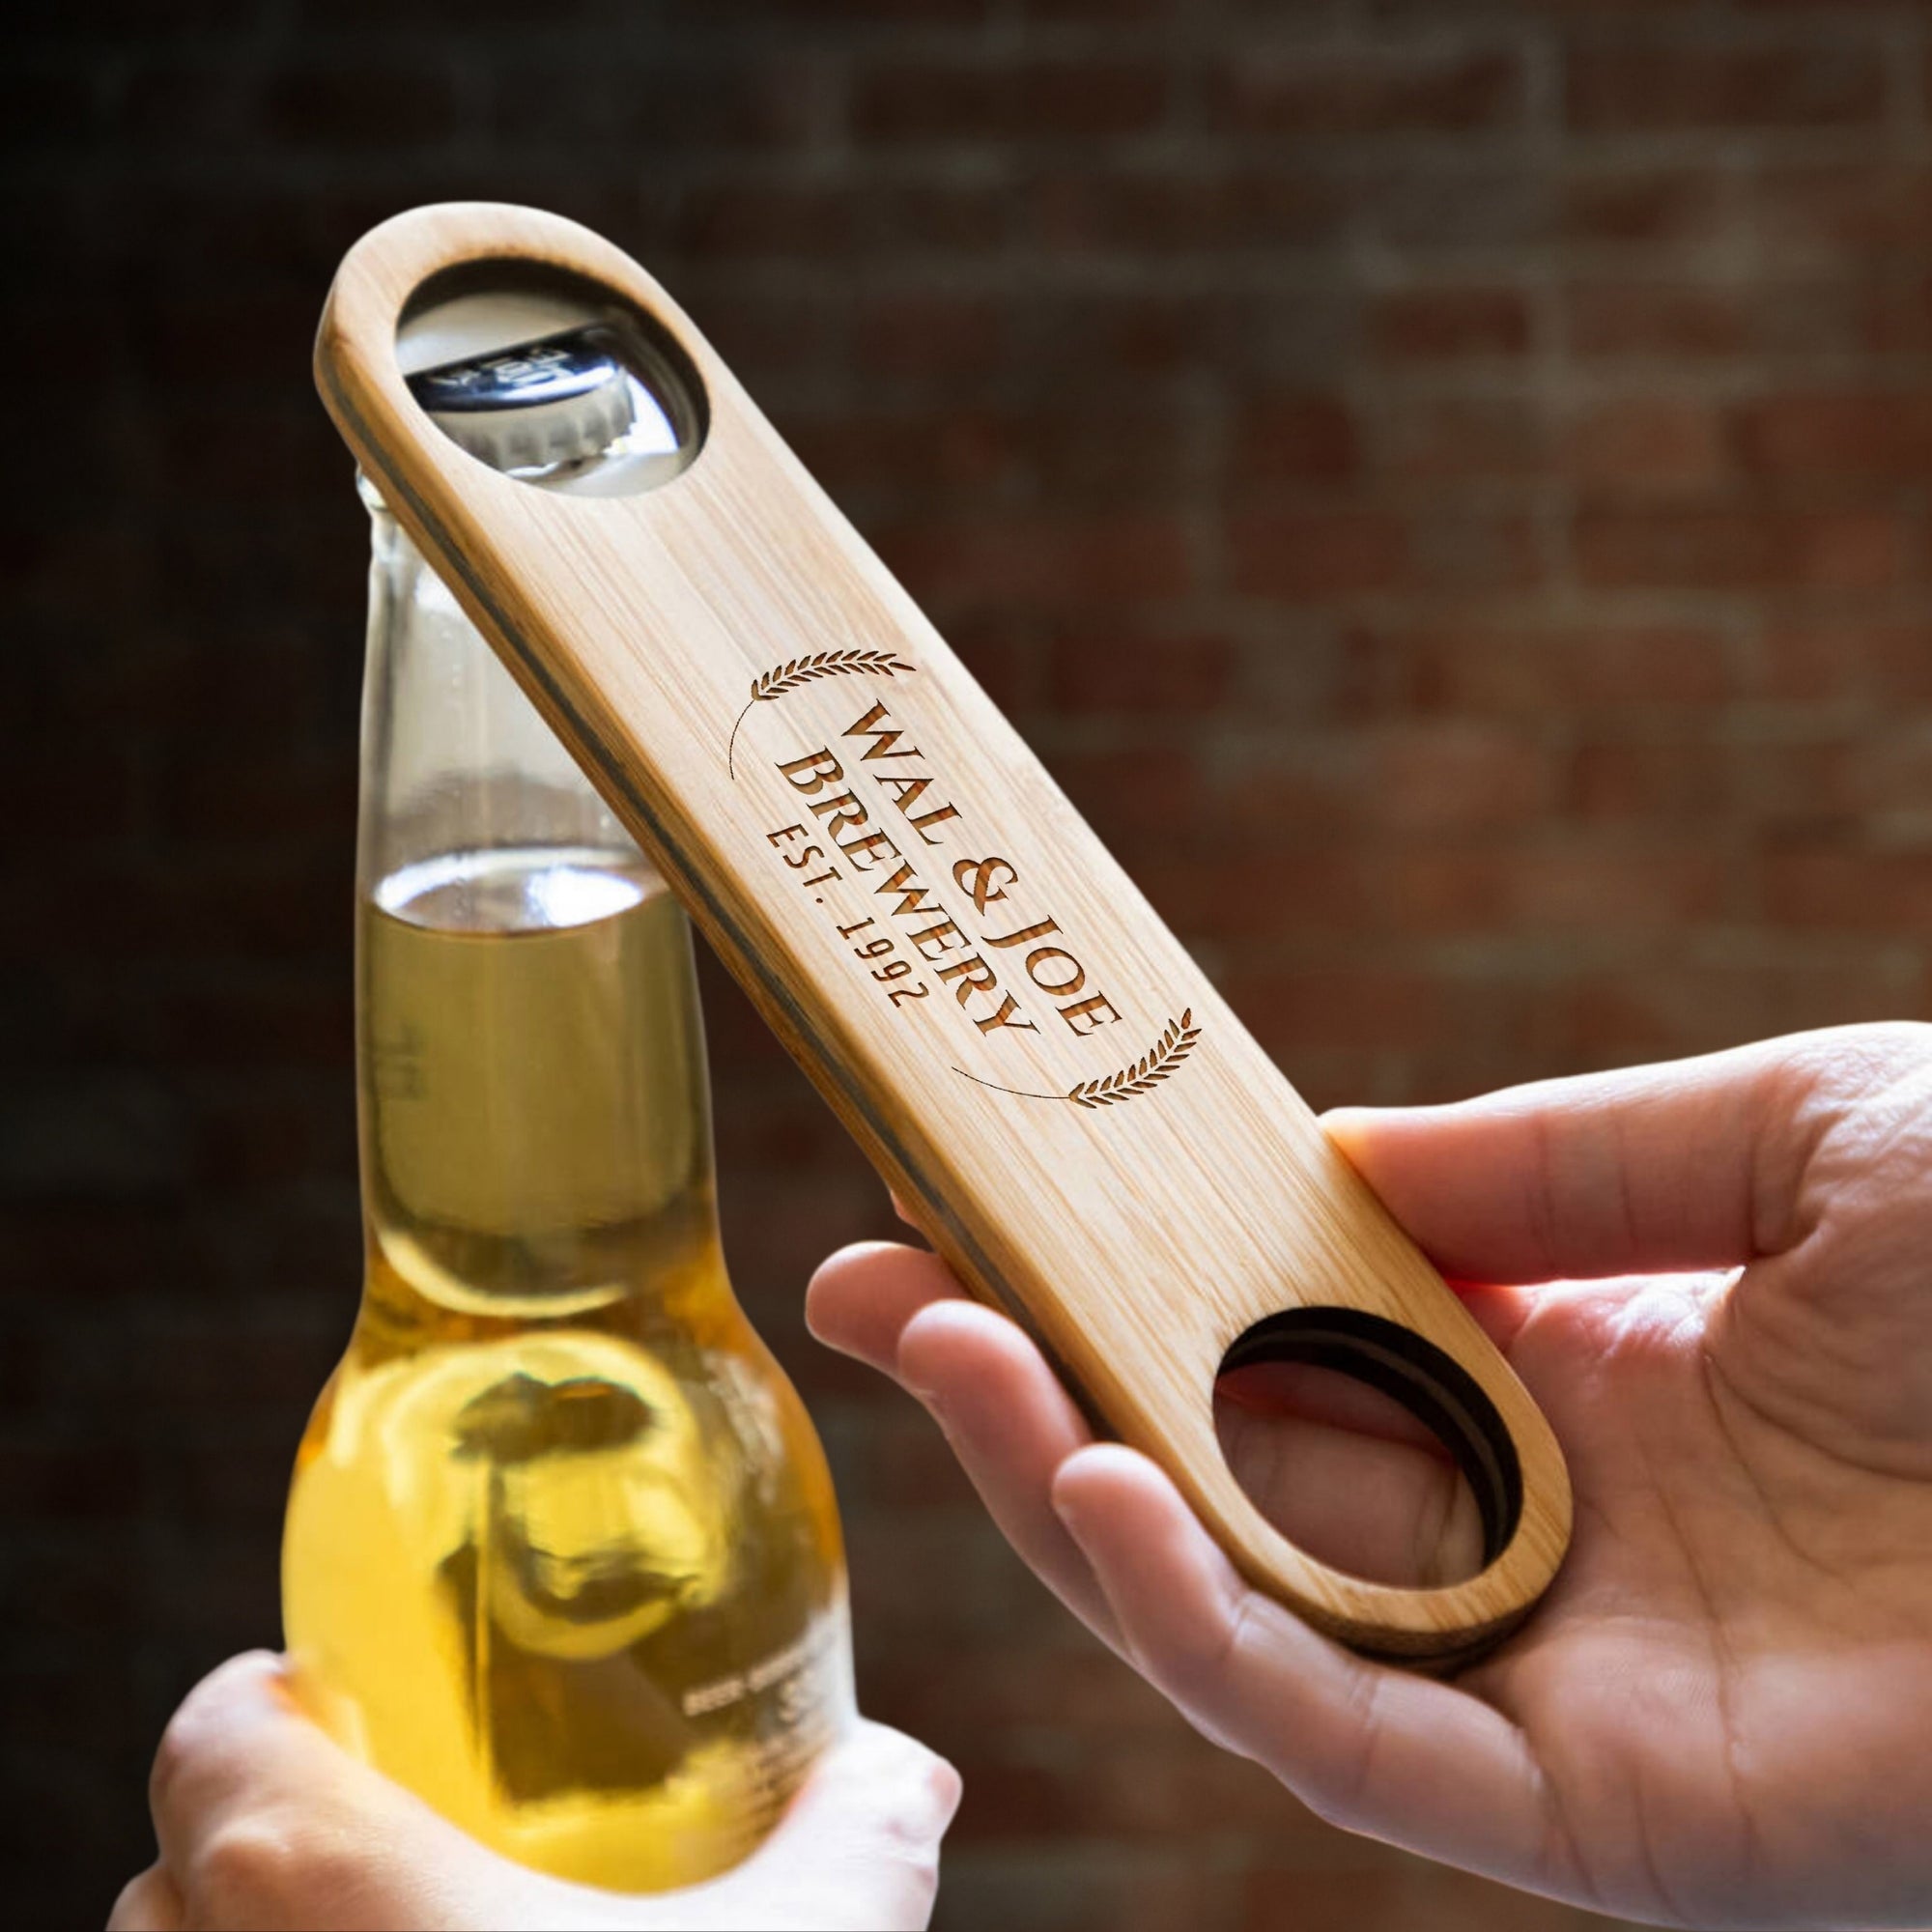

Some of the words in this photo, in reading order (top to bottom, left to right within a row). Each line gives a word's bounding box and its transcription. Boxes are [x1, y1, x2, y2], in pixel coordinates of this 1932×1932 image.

[839, 697, 963, 846] WAL
[765, 823, 843, 905] EST.
[835, 916, 930, 1009] 1992
[774, 744, 1041, 1037] BREWERY
[952, 856, 1019, 918] &
[980, 914, 1123, 1037] JOE
